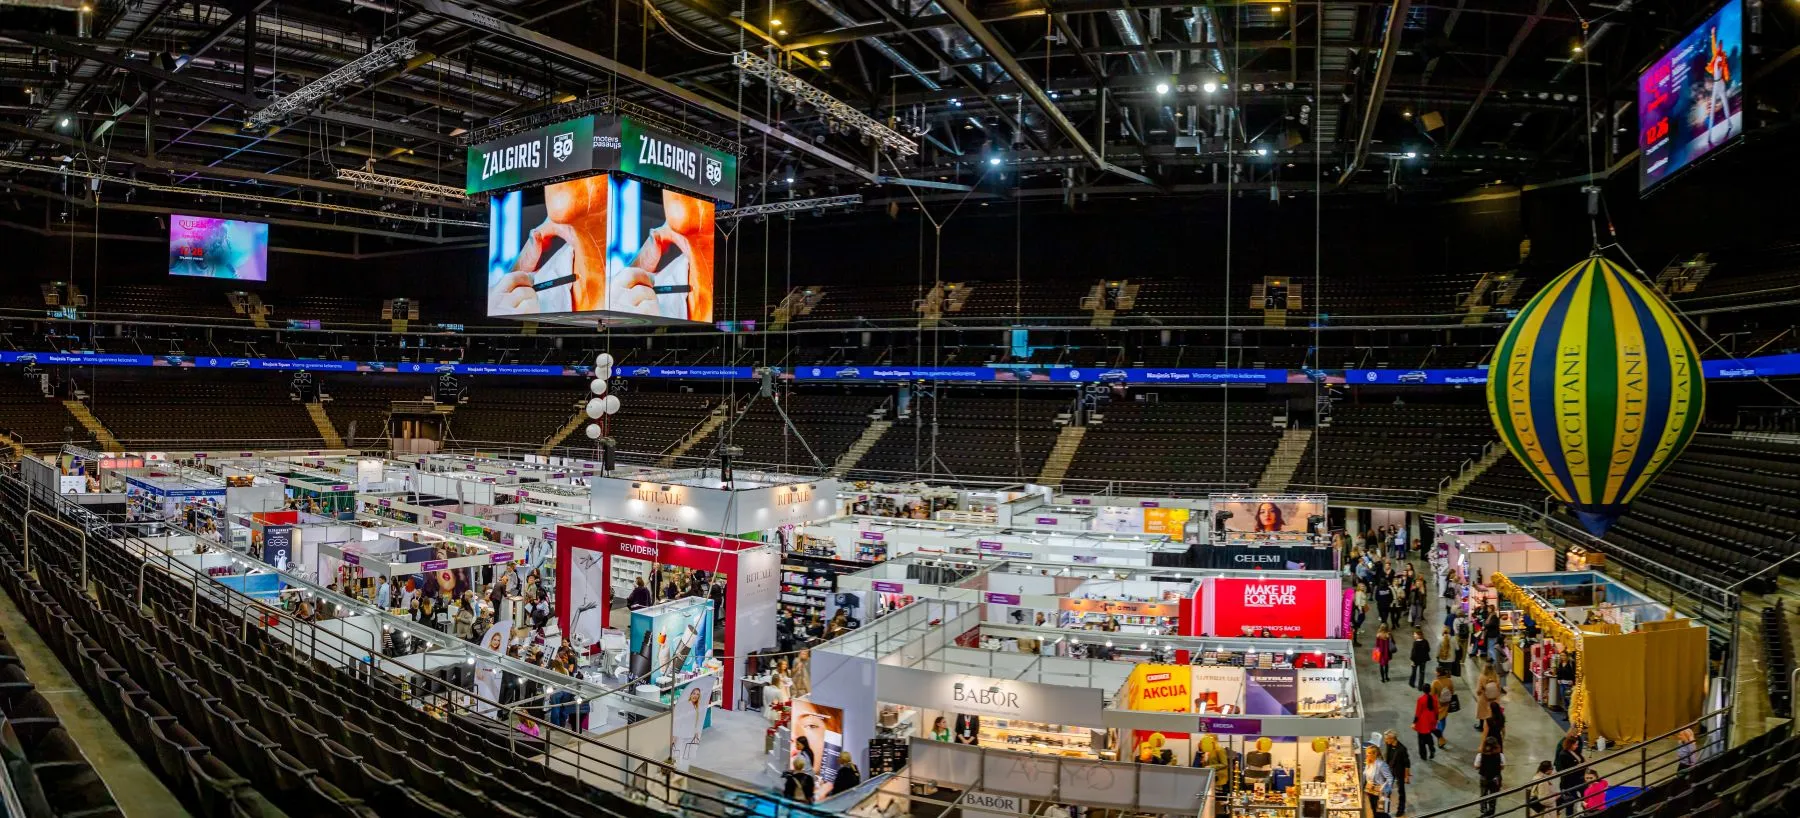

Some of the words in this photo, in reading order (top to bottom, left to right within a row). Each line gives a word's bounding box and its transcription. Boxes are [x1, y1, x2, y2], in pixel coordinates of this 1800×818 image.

[552, 139, 574, 159] 80
[593, 135, 619, 144] moters
[481, 139, 541, 181] ŽALGIRIS
[639, 134, 696, 181] ŽALGIRIS
[705, 161, 722, 179] 80
[1512, 345, 1556, 476] L'OCCITANE
[1562, 344, 1590, 477] L'OCCITANE
[1610, 345, 1643, 477] L'OCCITANE
[1643, 347, 1688, 476] L'OCCITANE
[620, 543, 659, 556] REVIDERM
[1234, 554, 1281, 563] CELEMI
[1244, 584, 1279, 595] MAKE
[1280, 584, 1297, 595] UP
[1244, 594, 1267, 605] FOR
[1269, 594, 1297, 605] EVER
[953, 686, 1020, 709] BABOR
[1143, 684, 1187, 700] AKCIJA
[966, 793, 1014, 811] BABOR
